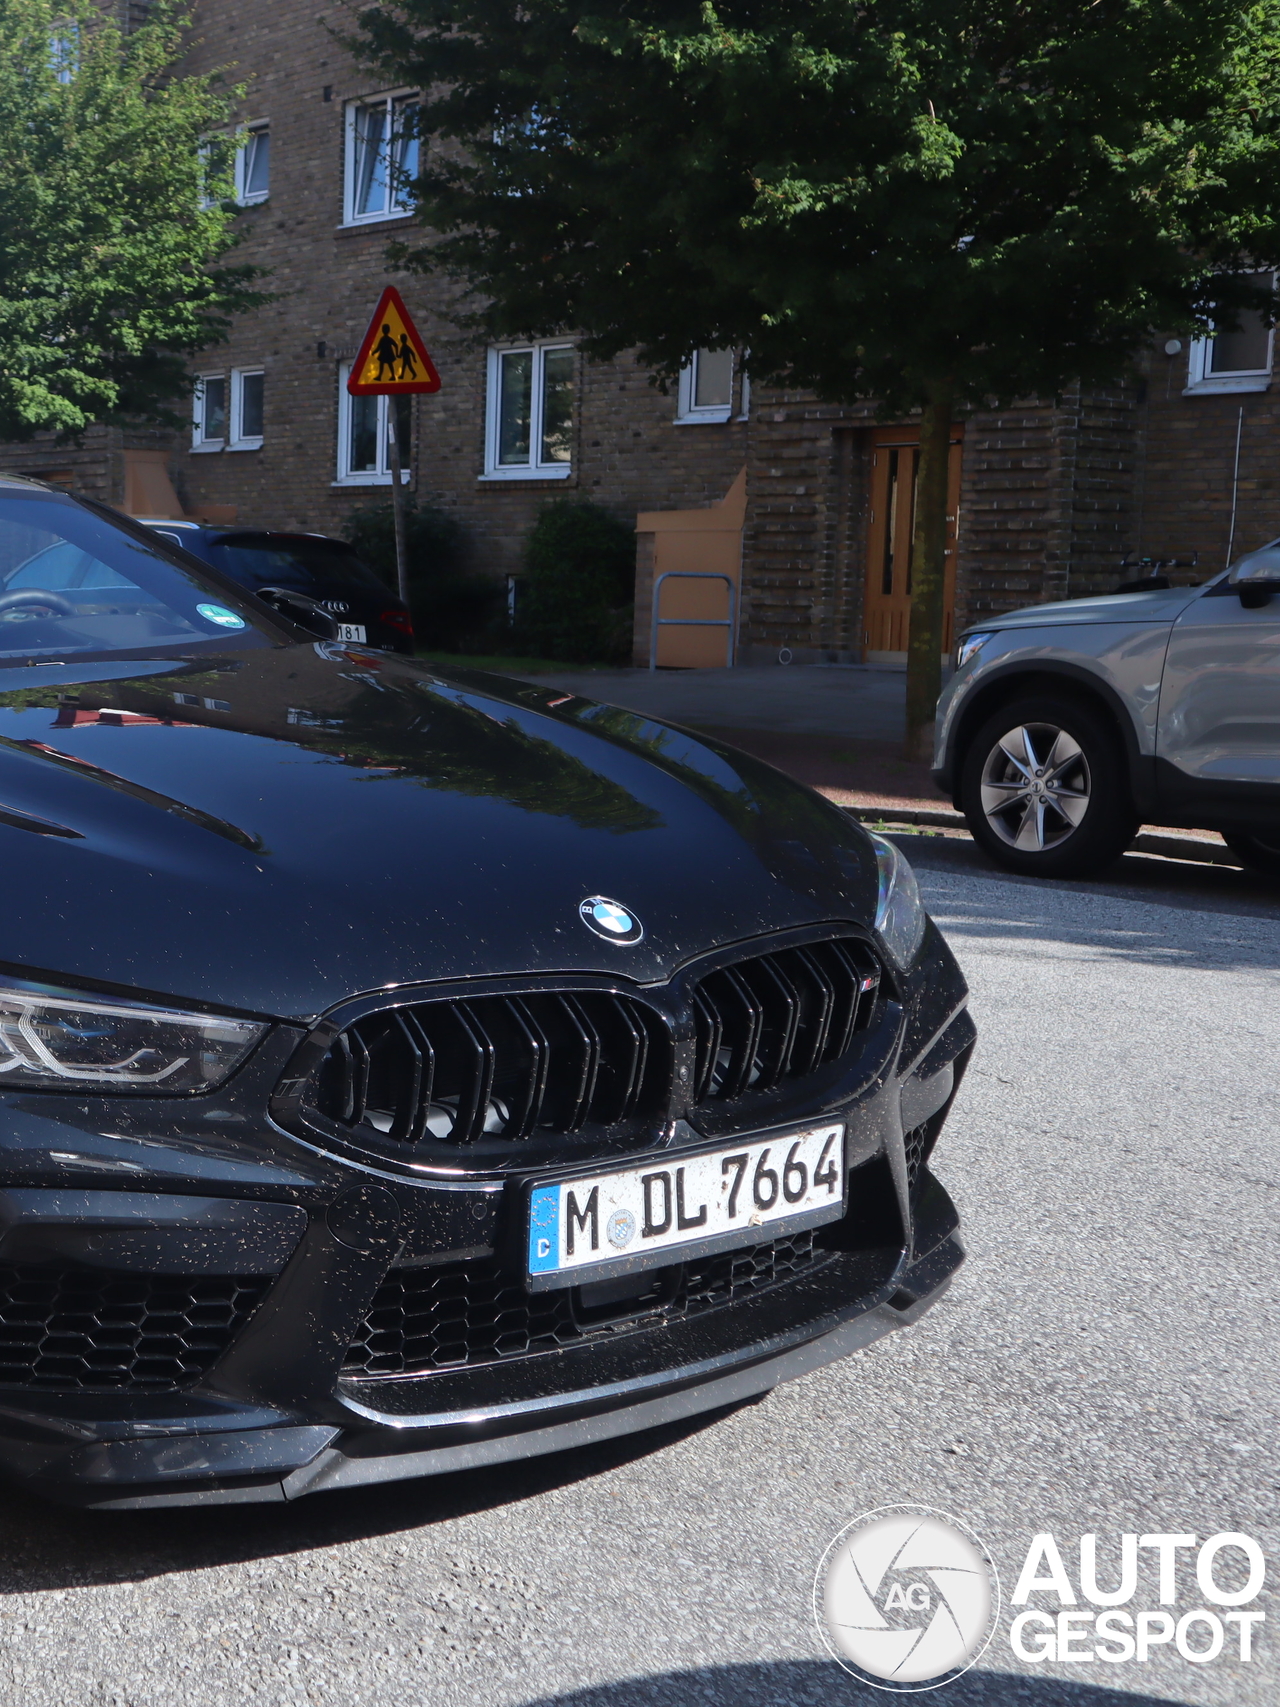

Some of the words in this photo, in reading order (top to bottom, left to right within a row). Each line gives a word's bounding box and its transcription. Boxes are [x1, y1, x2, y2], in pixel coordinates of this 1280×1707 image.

[338, 625, 360, 640] 181
[566, 1185, 599, 1257] M
[641, 1167, 708, 1239] DL
[721, 1132, 839, 1219] 7664
[537, 1238, 550, 1258] D
